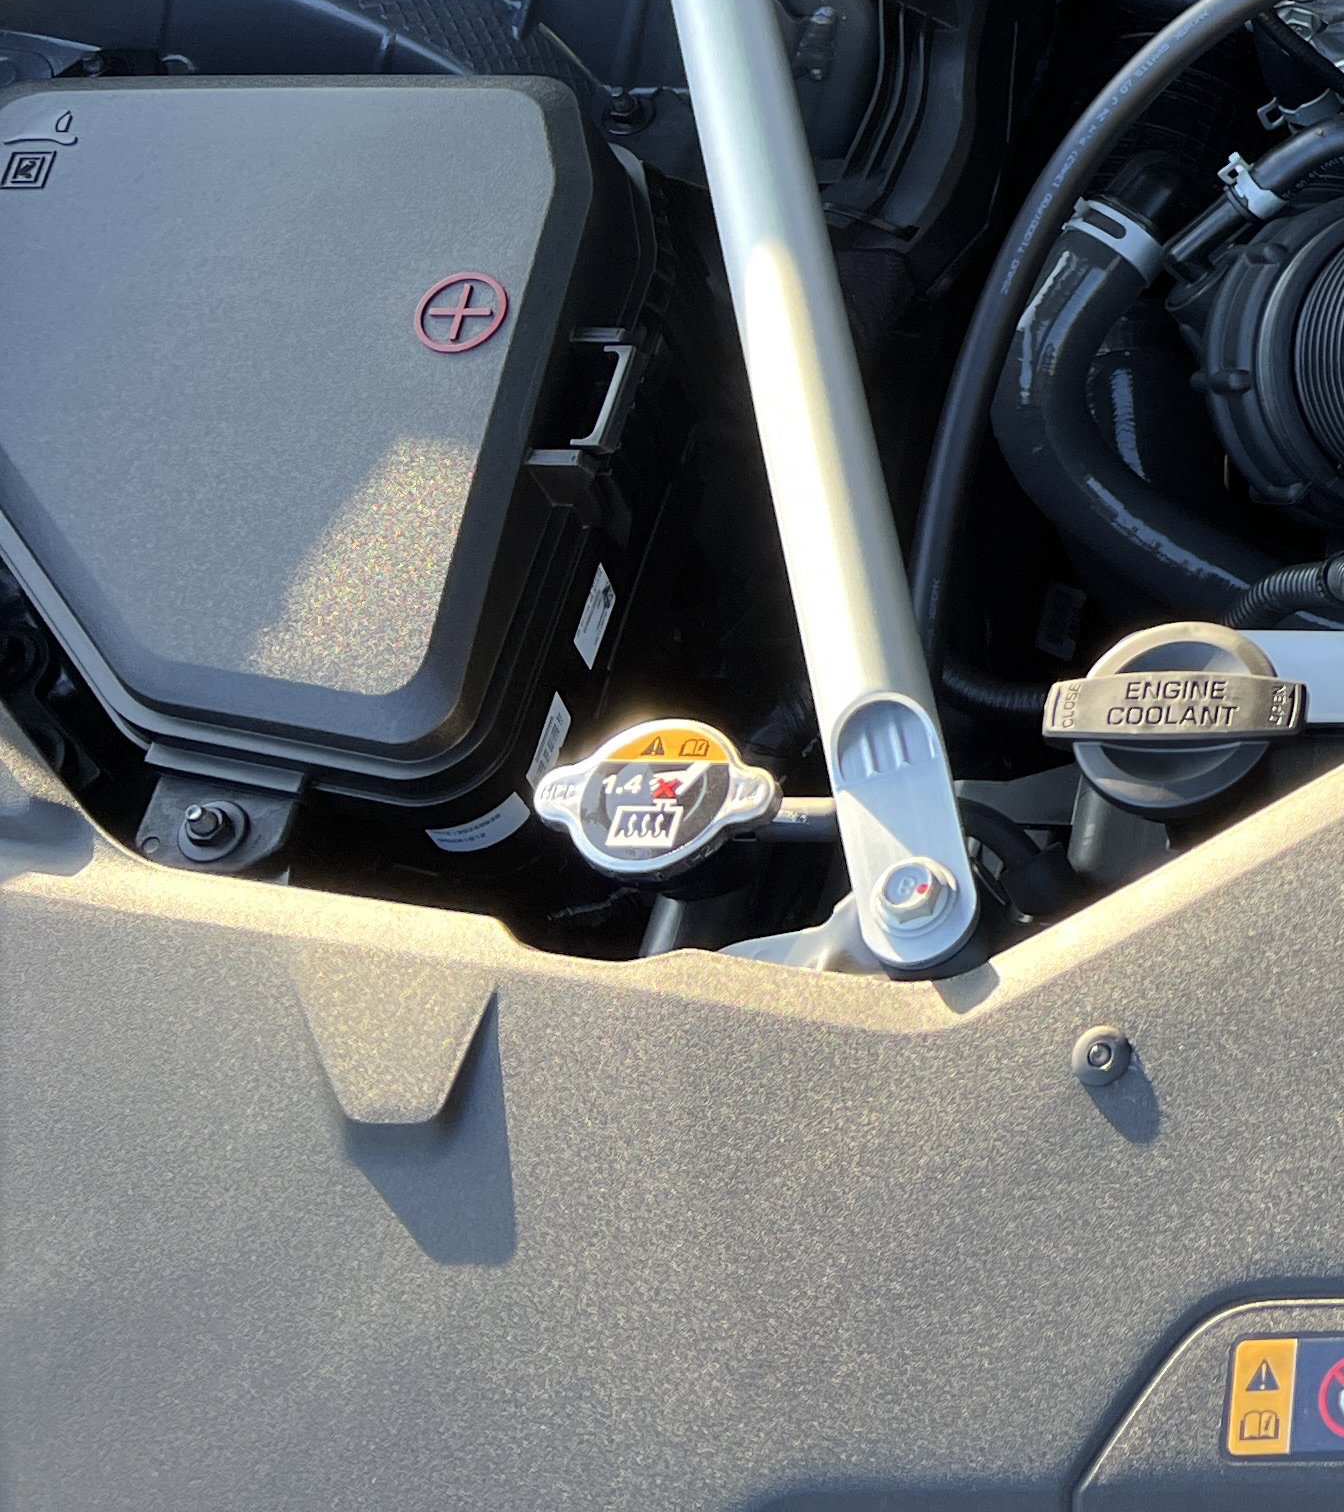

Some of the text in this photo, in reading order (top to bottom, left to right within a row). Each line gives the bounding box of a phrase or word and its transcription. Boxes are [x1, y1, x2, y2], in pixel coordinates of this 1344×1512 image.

[1125, 680, 1229, 701] ENGINE
[1062, 683, 1081, 728] CLOSE
[1106, 705, 1239, 726] COOLANT
[601, 774, 643, 795] 1.4
